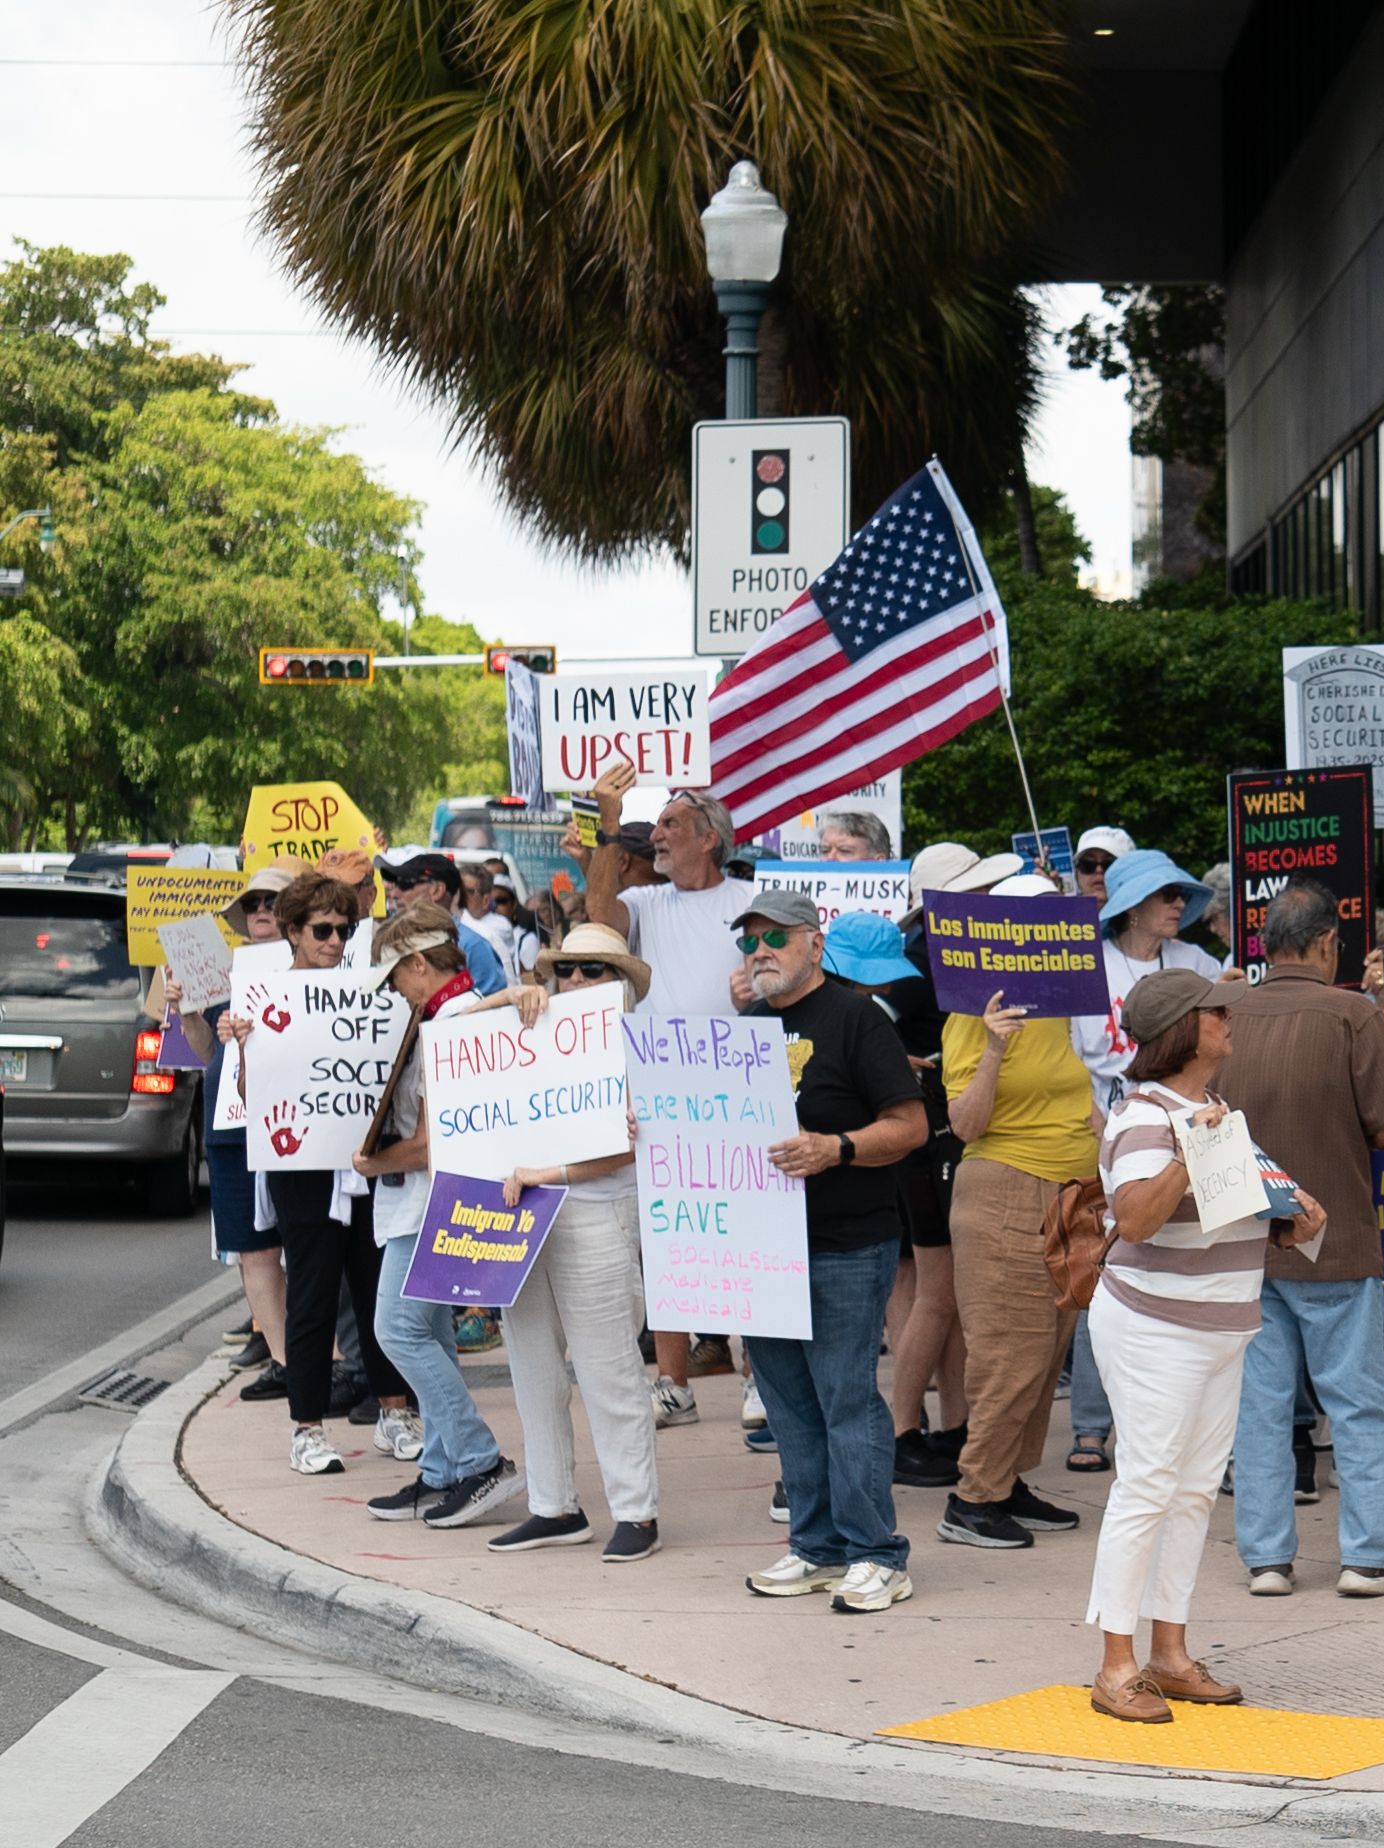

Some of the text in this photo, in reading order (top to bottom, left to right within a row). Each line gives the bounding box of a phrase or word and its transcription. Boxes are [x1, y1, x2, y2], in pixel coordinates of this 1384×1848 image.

[732, 567, 808, 593] PHOTO
[1308, 652, 1349, 674] HERE
[554, 682, 696, 725] I AM VERY
[1311, 704, 1382, 724] SOCIAL
[561, 729, 692, 781] UPSET!
[271, 796, 339, 833] STOP
[1243, 790, 1305, 816] WHEN
[1244, 815, 1341, 845] INJUSTICE
[1245, 844, 1338, 872] BECOMES
[136, 875, 245, 892] UNDOCUMENTED
[845, 878, 907, 900] MUSK
[1245, 875, 1289, 902] LAW
[928, 911, 1096, 946] Los inmigrantes
[941, 947, 1096, 972] son Esenciales
[304, 982, 394, 1014] HANDS
[331, 1016, 391, 1043] OFF
[434, 1007, 616, 1082] HANDS OFF
[620, 1015, 771, 1087] We The People
[309, 1056, 390, 1087] SOCI
[300, 1091, 377, 1117] SECUR
[439, 1074, 625, 1137] SOCIAL SECURITY
[1197, 1158, 1248, 1209] DECENCY
[450, 1199, 535, 1234] Imigran Yo
[650, 1200, 729, 1235] SAVE
[669, 1242, 749, 1269] SOCIAL
[657, 1271, 754, 1293] Medicare
[656, 1297, 752, 1321] Medicaid
